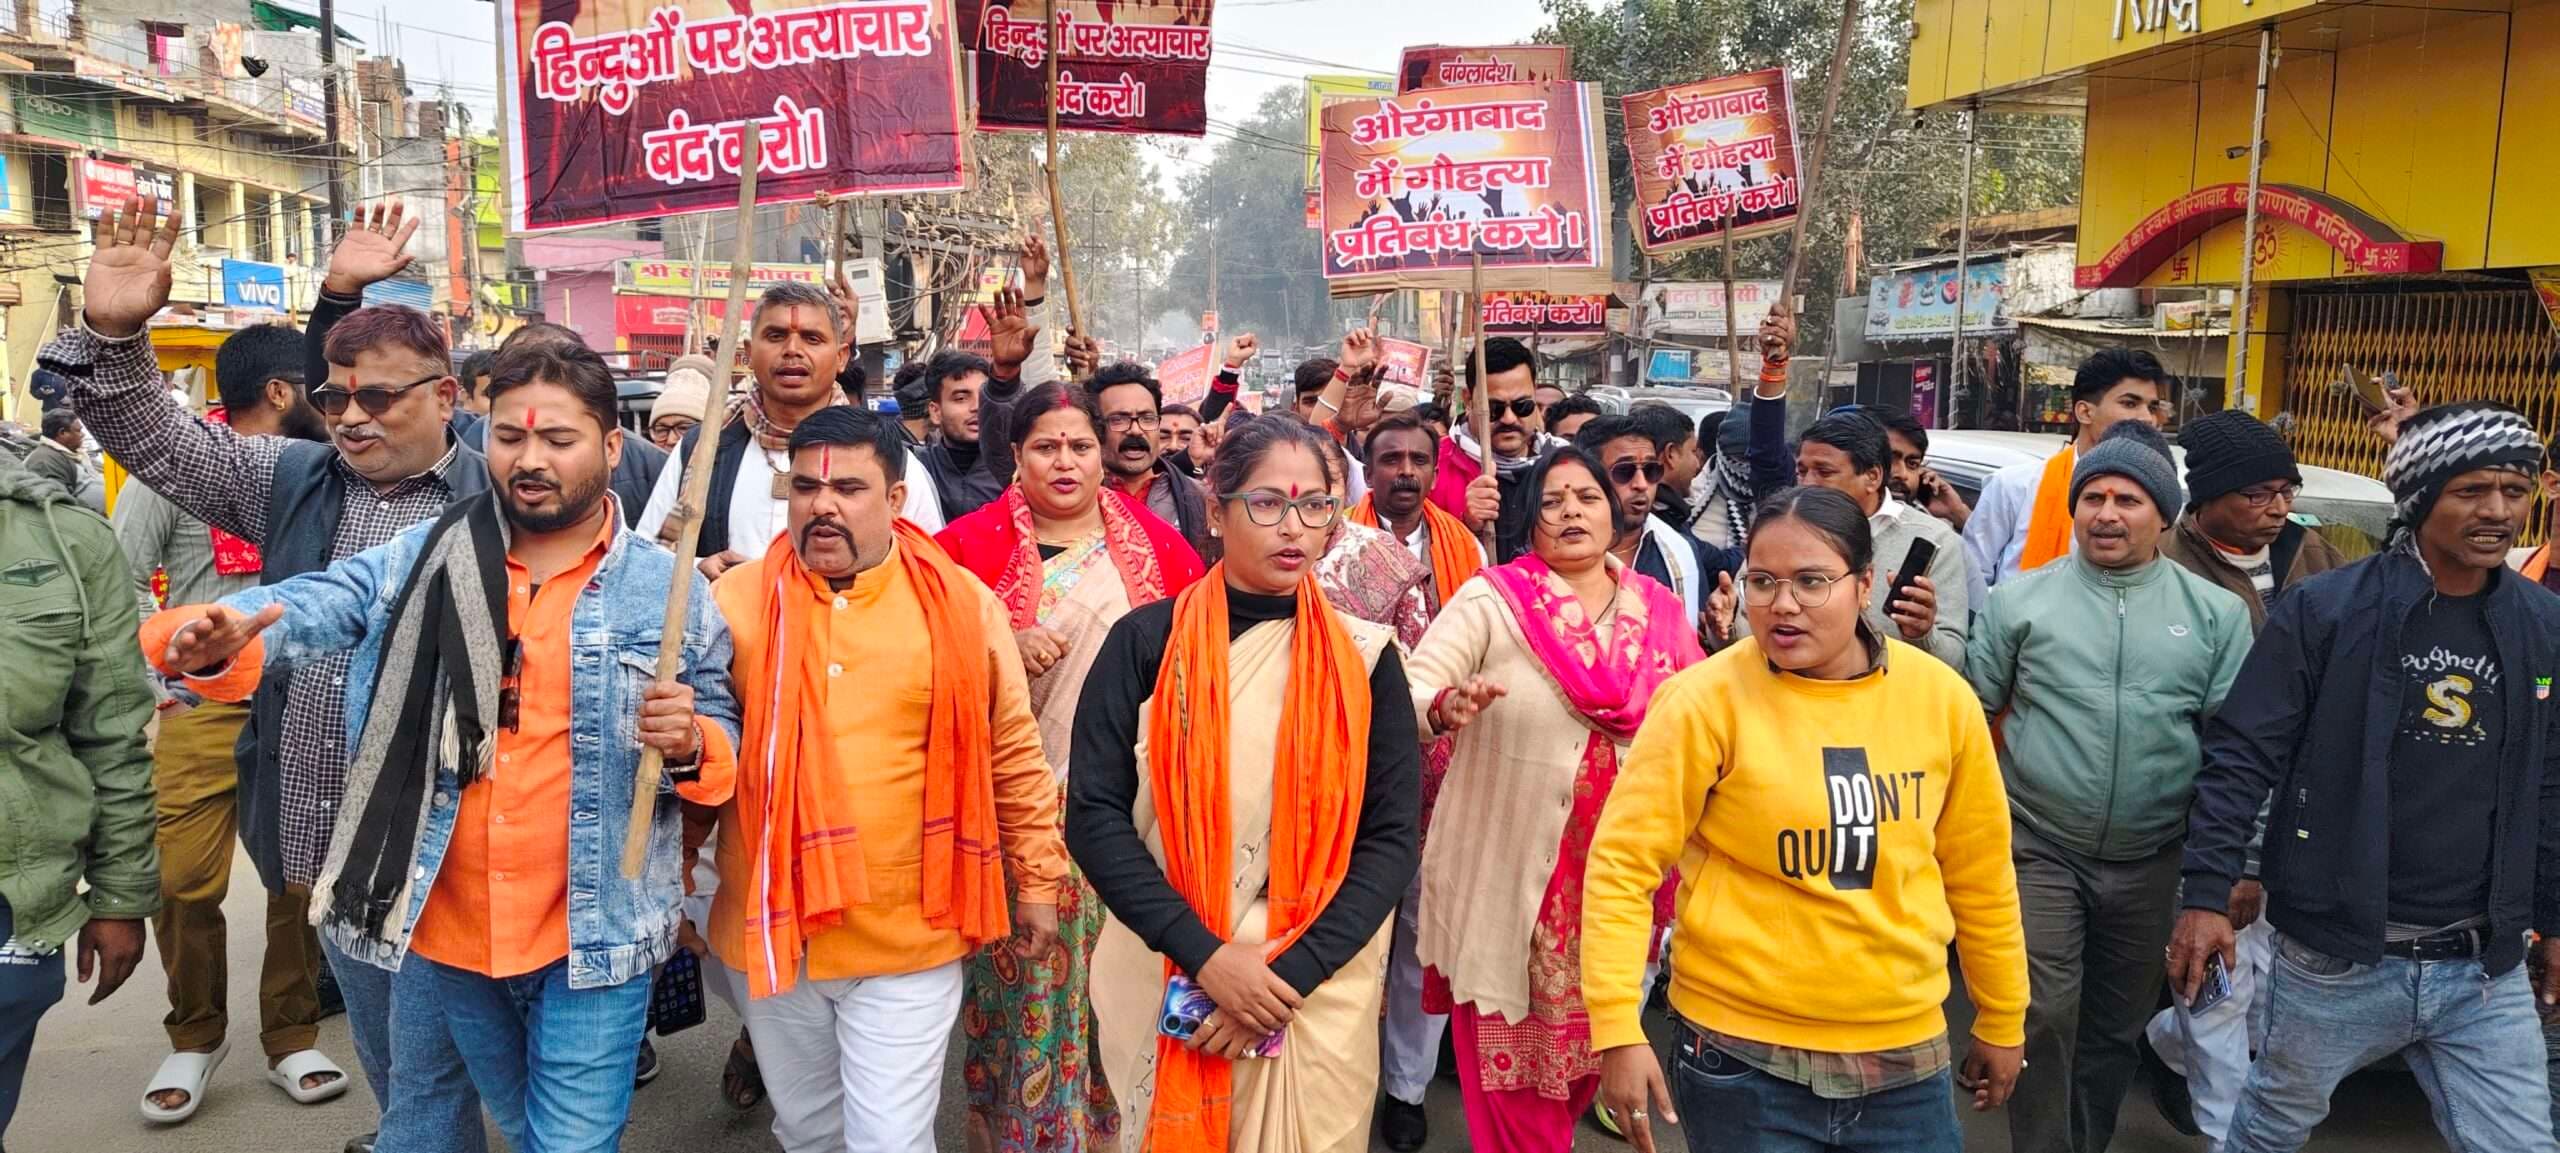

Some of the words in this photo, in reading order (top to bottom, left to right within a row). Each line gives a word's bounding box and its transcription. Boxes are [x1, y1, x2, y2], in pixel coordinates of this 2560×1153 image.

[533, 10, 683, 114] हिन्दुओं
[685, 16, 746, 74] पर
[748, 2, 932, 69] अत्याचार
[1074, 22, 1107, 55] पर
[1109, 24, 1210, 60] अत्याचार
[1440, 55, 1514, 84] बांग्लादेश
[1648, 88, 1767, 135] औरंगाबाद
[643, 109, 714, 184] बंद
[1656, 143, 1686, 180] में
[1690, 134, 1776, 173] गौहत्या
[1355, 156, 1399, 199] में
[1402, 152, 1551, 195] गौहत्या
[1648, 186, 1738, 236] प्रतिबंध
[2258, 189, 2312, 225] गणपति
[2315, 210, 2363, 259] मन्दिर
[1332, 212, 1474, 267] प्रतिबंध
[237, 275, 280, 305] vivo
[1829, 771, 1926, 825] DON'T
[1777, 826, 1875, 880] QUIT
